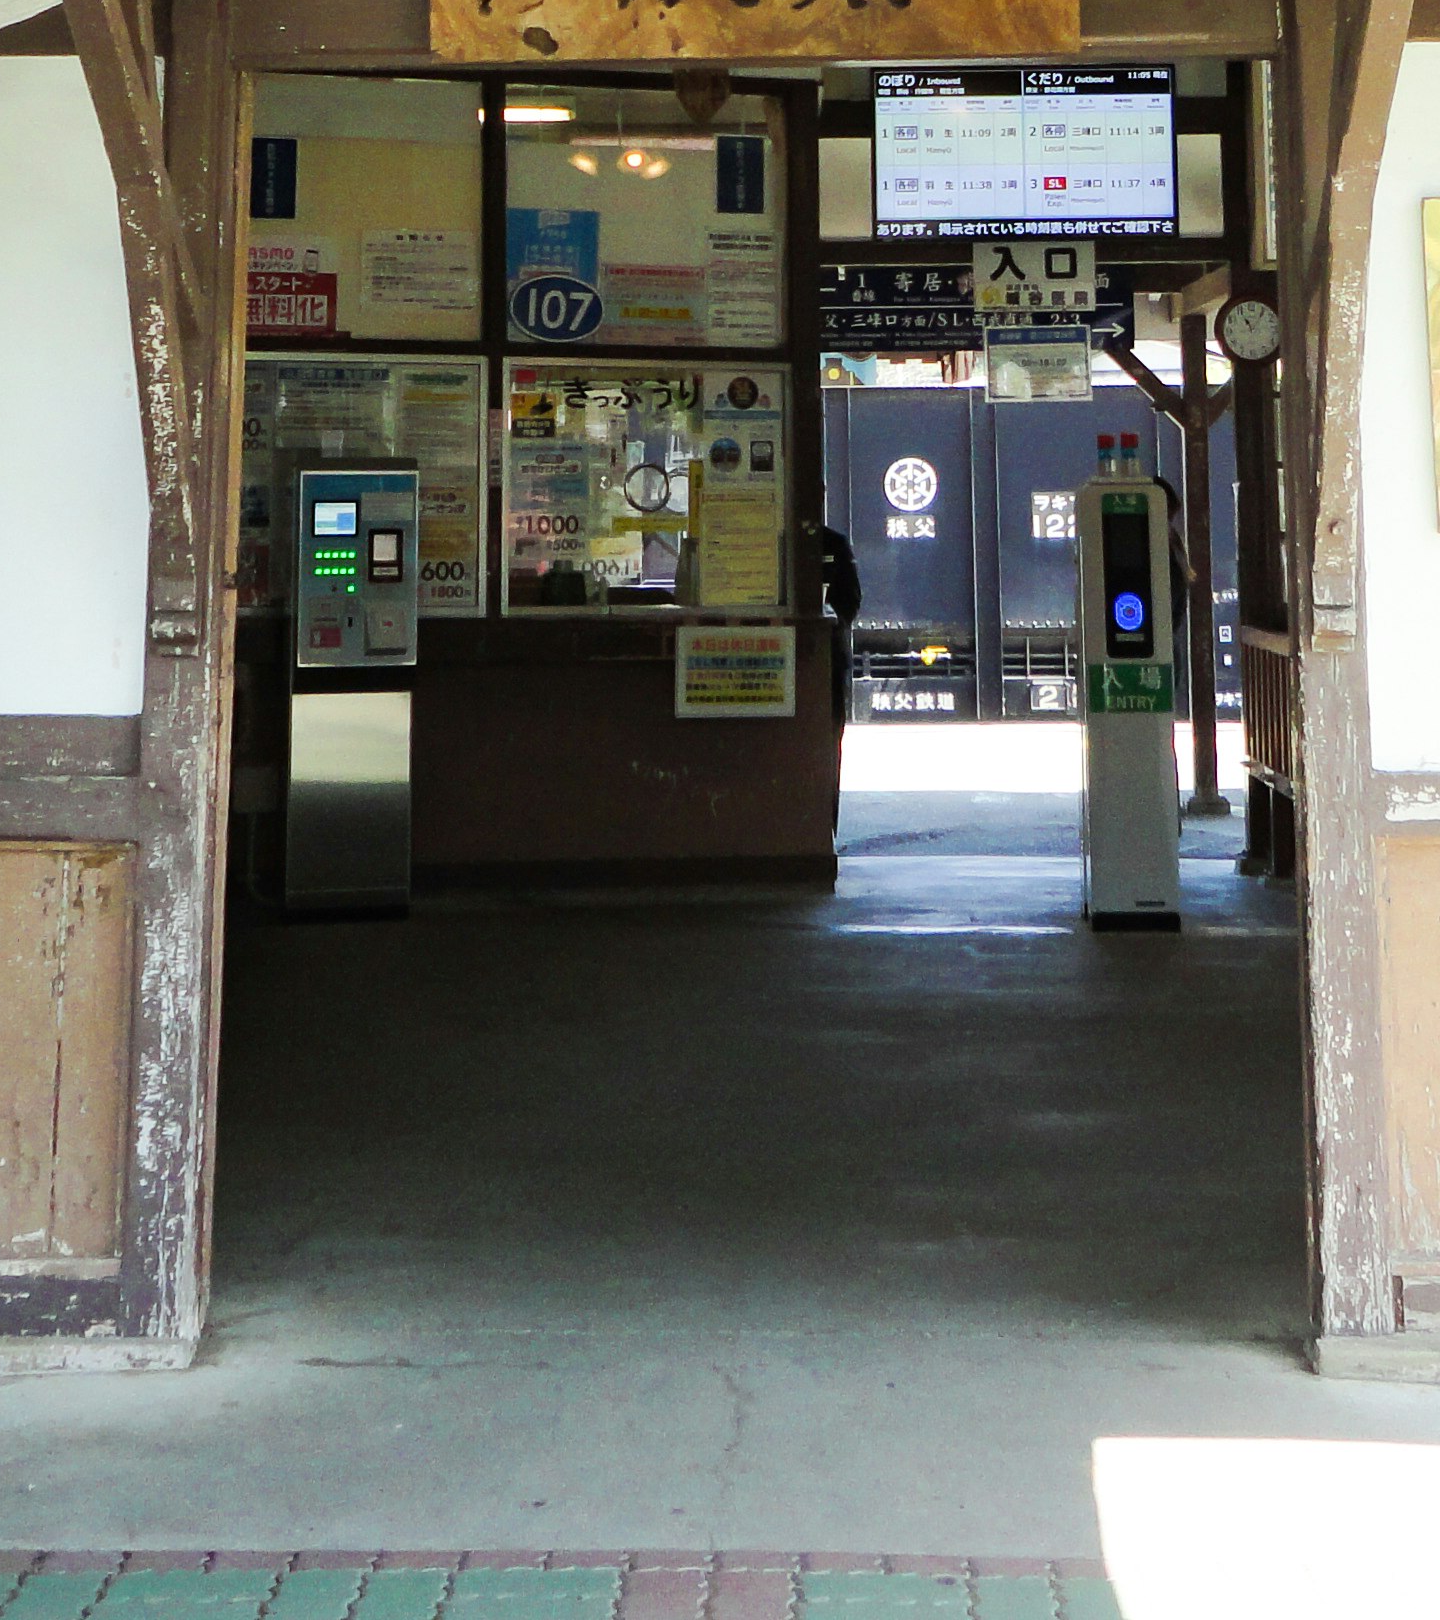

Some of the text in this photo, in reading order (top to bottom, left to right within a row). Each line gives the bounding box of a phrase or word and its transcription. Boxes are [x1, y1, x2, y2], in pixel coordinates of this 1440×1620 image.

[878, 74, 915, 87] のぼり
[926, 77, 962, 86] Inbound
[1027, 72, 1063, 85] くだり
[1074, 75, 1114, 84] Outbound
[881, 128, 889, 138] 1
[961, 128, 991, 138] 11:09
[1029, 126, 1036, 136] 2
[1109, 126, 1139, 136] 11:14
[882, 180, 889, 190] 1
[962, 180, 992, 190] 11:38
[1030, 179, 1038, 189] 3
[1048, 179, 1063, 188] SL
[1111, 179, 1140, 188] 11:37
[990, 246, 1077, 280] 入口
[255, 276, 302, 292] スタート
[528, 288, 594, 331] 107
[1033, 495, 1075, 511] ヲキ
[887, 517, 936, 539] 秩父
[1102, 665, 1162, 690] 入場
[872, 692, 955, 711] 秩父鉄道
[1039, 685, 1059, 709] 2
[1106, 695, 1157, 711] ENTRY
